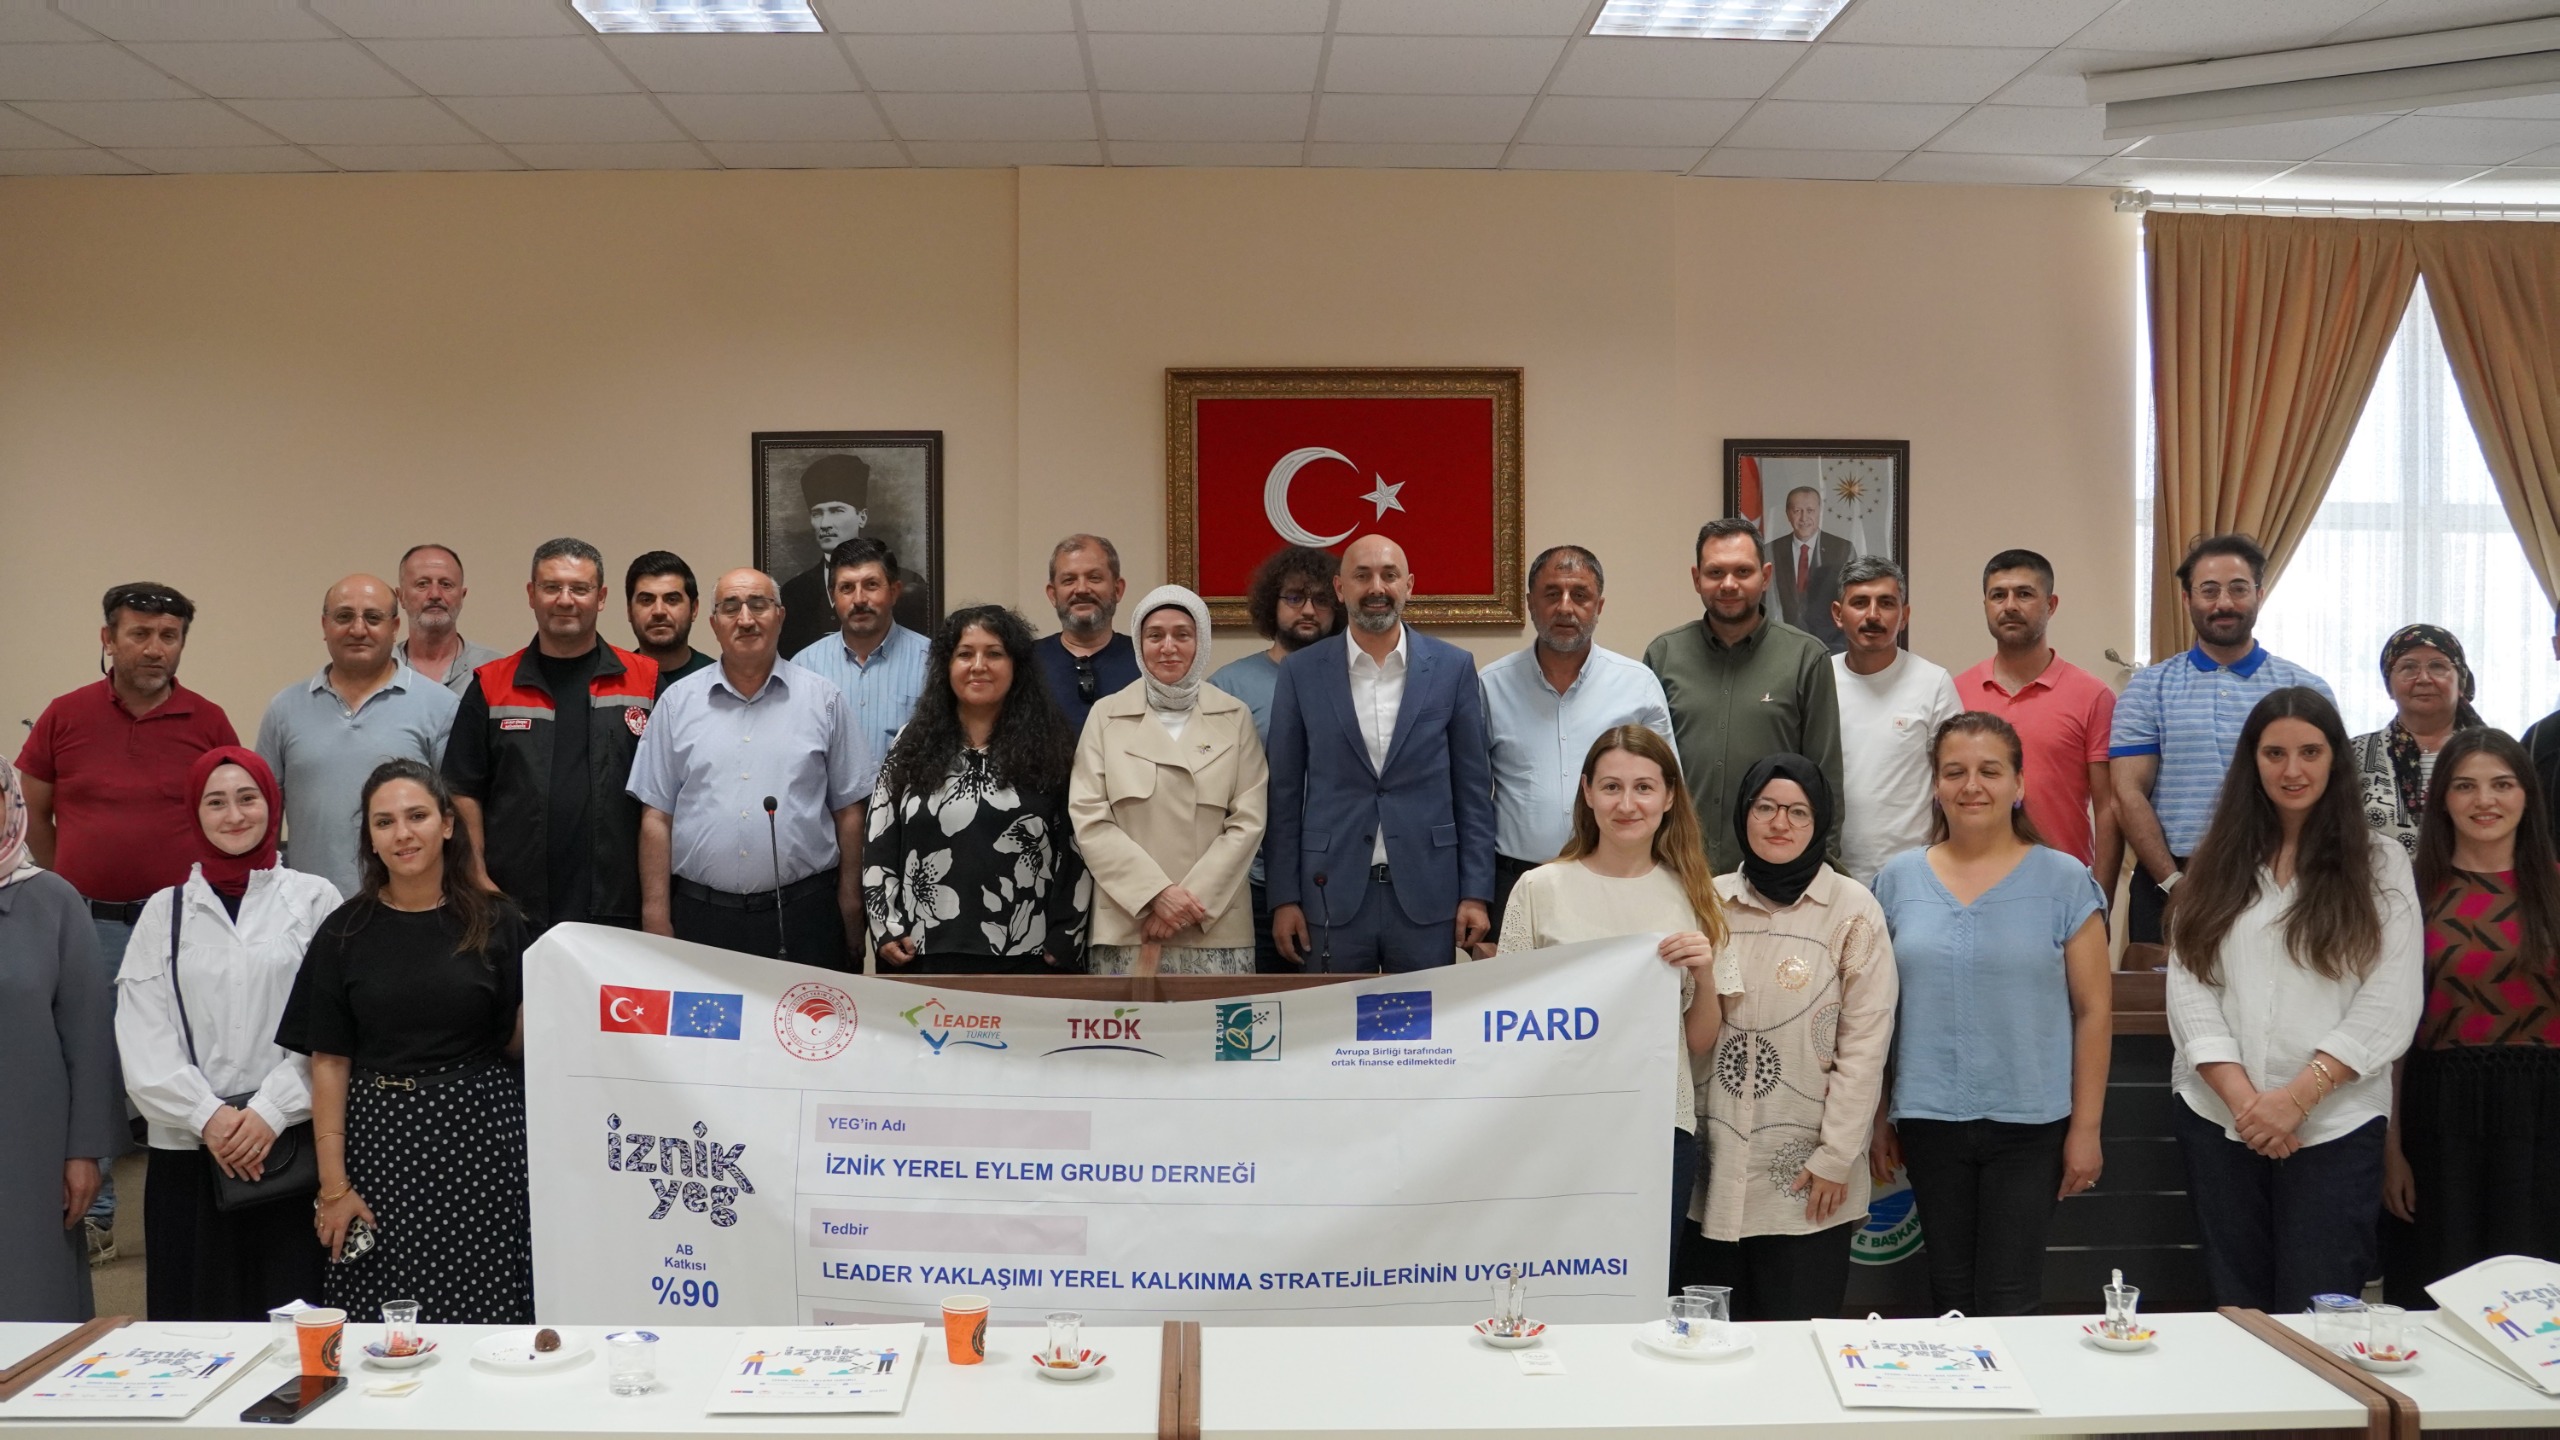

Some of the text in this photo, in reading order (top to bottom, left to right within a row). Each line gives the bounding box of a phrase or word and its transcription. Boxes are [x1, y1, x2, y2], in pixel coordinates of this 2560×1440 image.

[933, 1014, 1002, 1029] LEADER
[1483, 1007, 1599, 1042] IPARD
[966, 1030, 1001, 1039] TÜRKİYE
[1067, 1018, 1141, 1040] TKDK
[1215, 1007, 1225, 1053] LEADER
[1335, 1046, 1453, 1057] Avrupa Birliği tarafından
[1331, 1057, 1457, 1067] ortak finanse edilmektedir
[881, 1118, 906, 1132] Adı
[607, 1112, 756, 1194] iznik
[826, 1152, 1256, 1184] İZNİK YEREL EYLEM GRUBU DERNEĞİ
[648, 1178, 739, 1227] yeg
[822, 1222, 869, 1236] Tedbir
[675, 1244, 694, 1256] AB
[664, 1257, 707, 1271] Katkısı
[823, 1258, 1628, 1291] LEADER YAKLAŞIMI YEREL KALKINMA STRATEJİLERİNİN UYGULANMASI
[651, 1275, 719, 1308] %90
[125, 1347, 205, 1360] iznik
[784, 1345, 866, 1357] iznik
[1870, 1340, 1954, 1353] iznik
